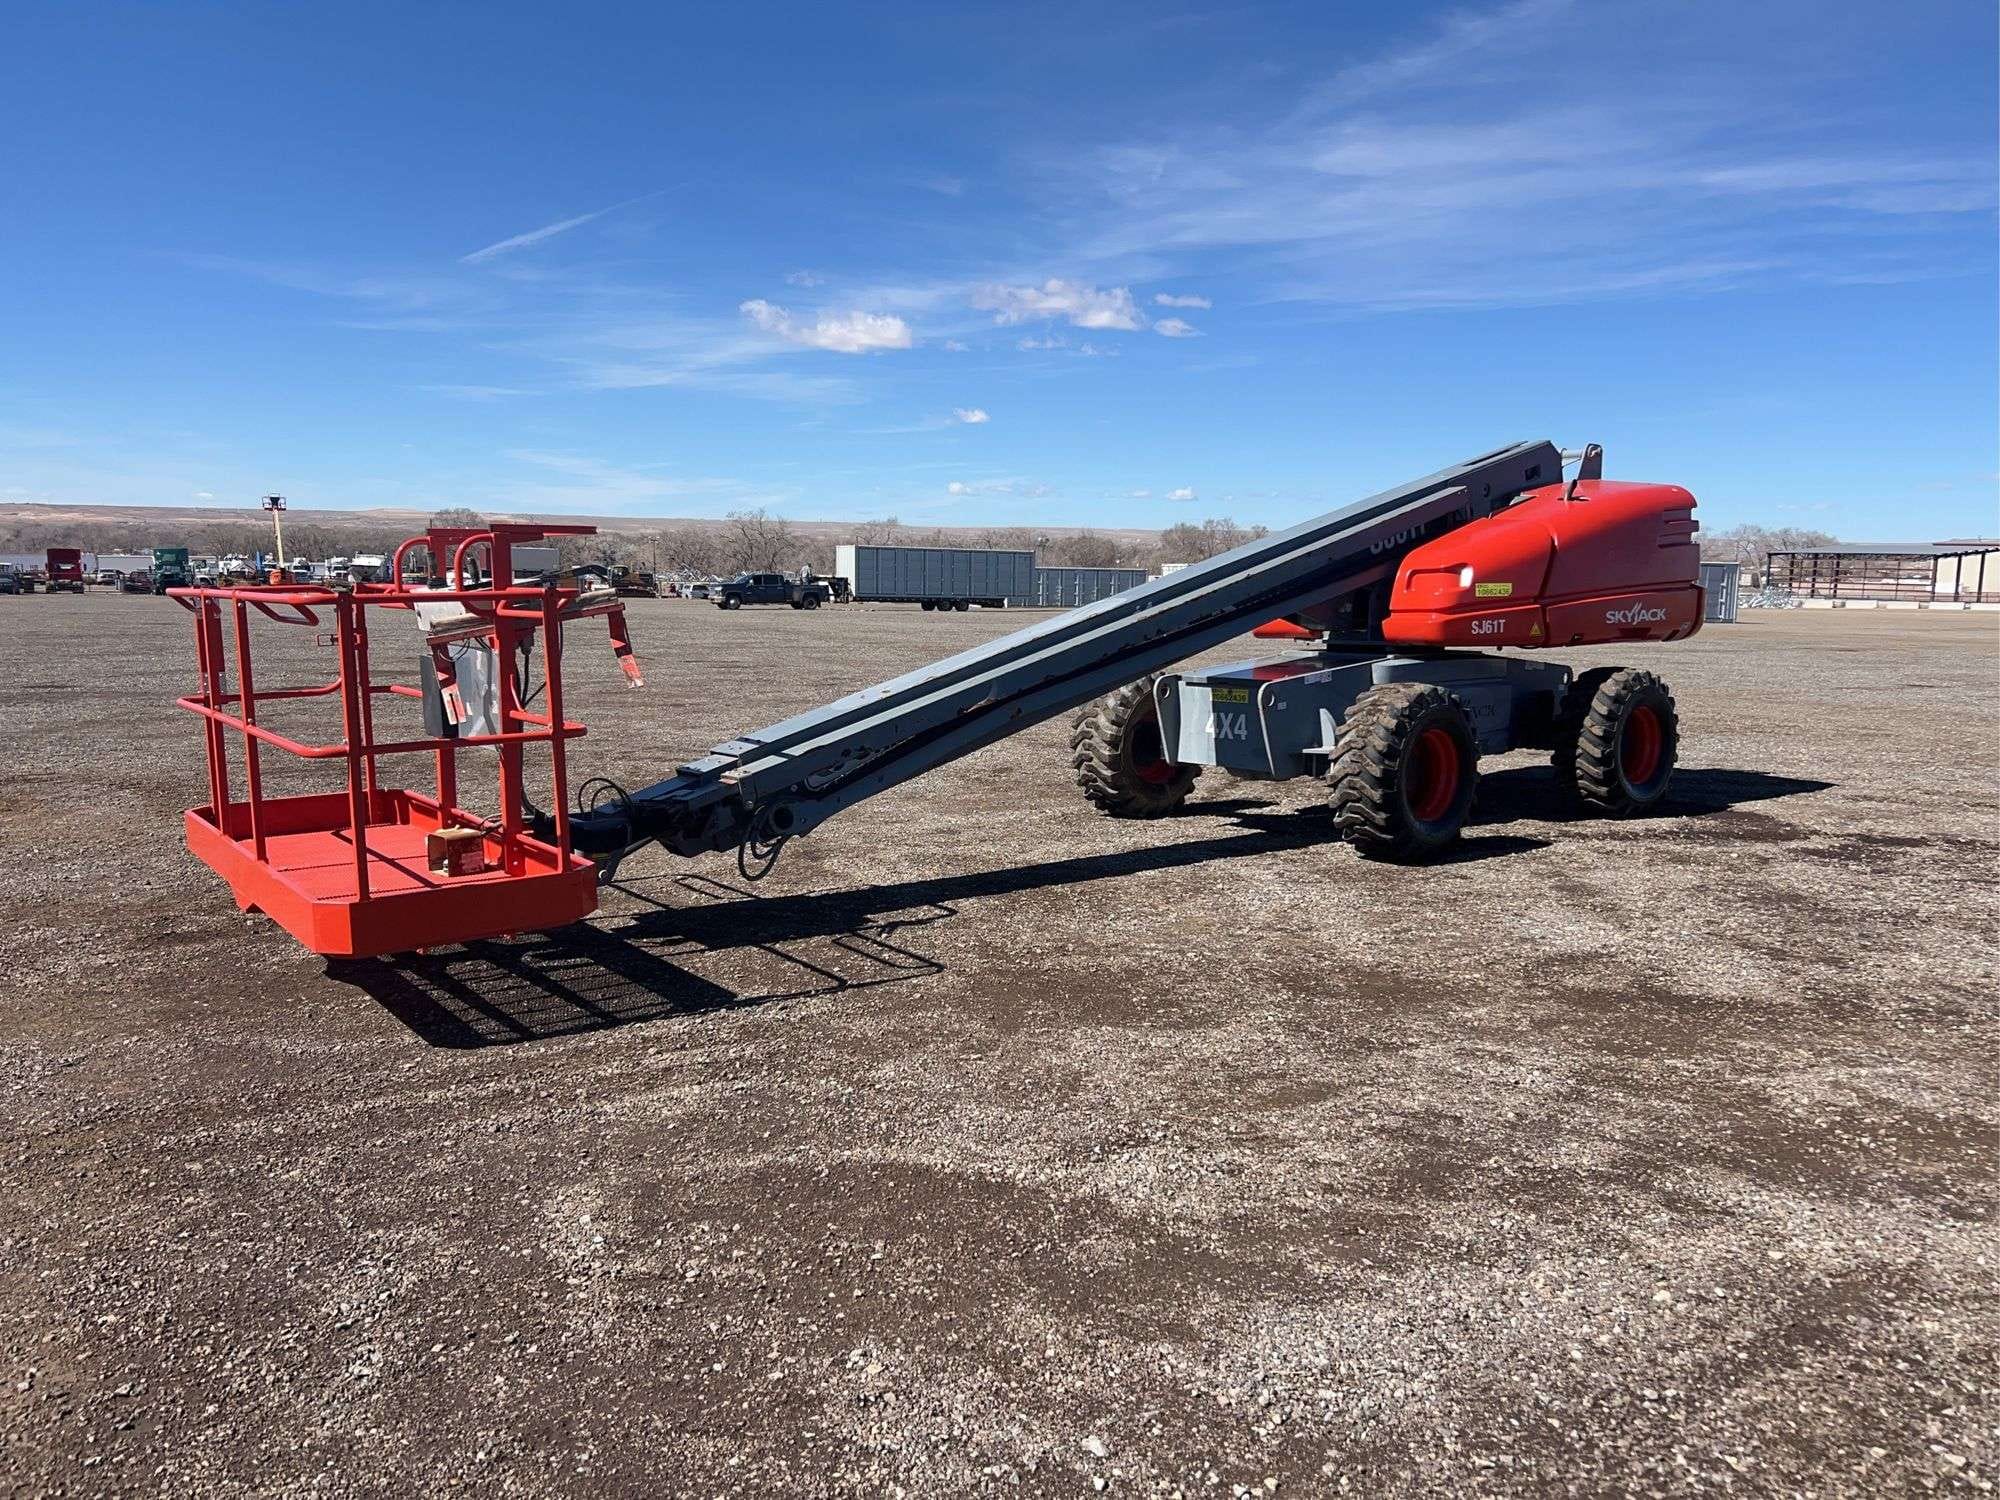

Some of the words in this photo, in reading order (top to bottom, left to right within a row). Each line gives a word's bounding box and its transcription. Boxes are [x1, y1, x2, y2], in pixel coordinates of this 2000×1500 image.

[1606, 602, 1666, 625] SKYJACK
[1471, 619, 1506, 634] SJ61T
[1205, 712, 1248, 740] 4X4
